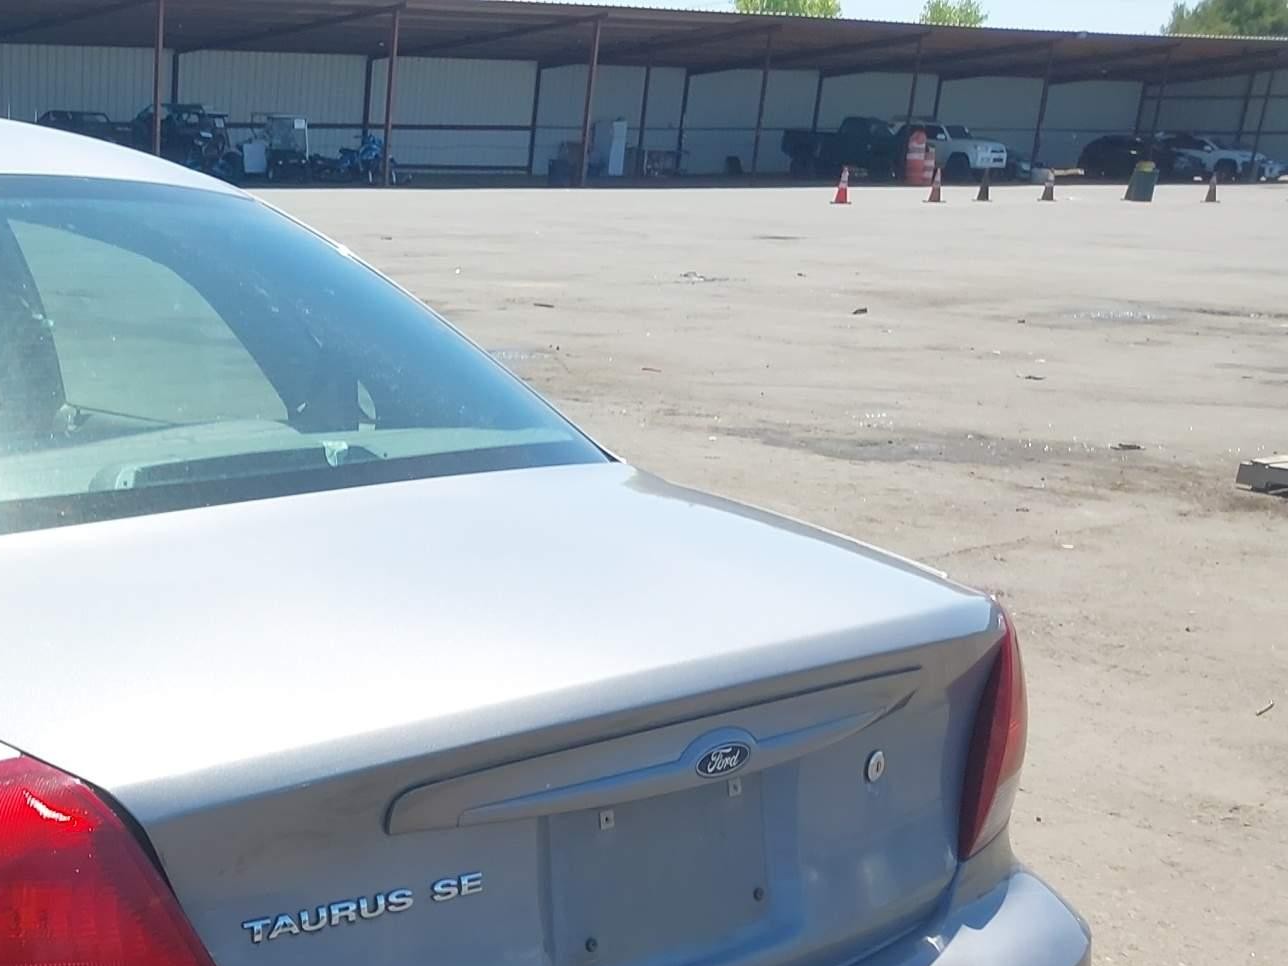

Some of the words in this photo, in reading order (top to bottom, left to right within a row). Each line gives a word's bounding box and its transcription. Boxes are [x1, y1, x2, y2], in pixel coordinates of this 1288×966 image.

[706, 746, 741, 774] Ford
[242, 888, 414, 943] TAURUS
[430, 871, 484, 902] SE
